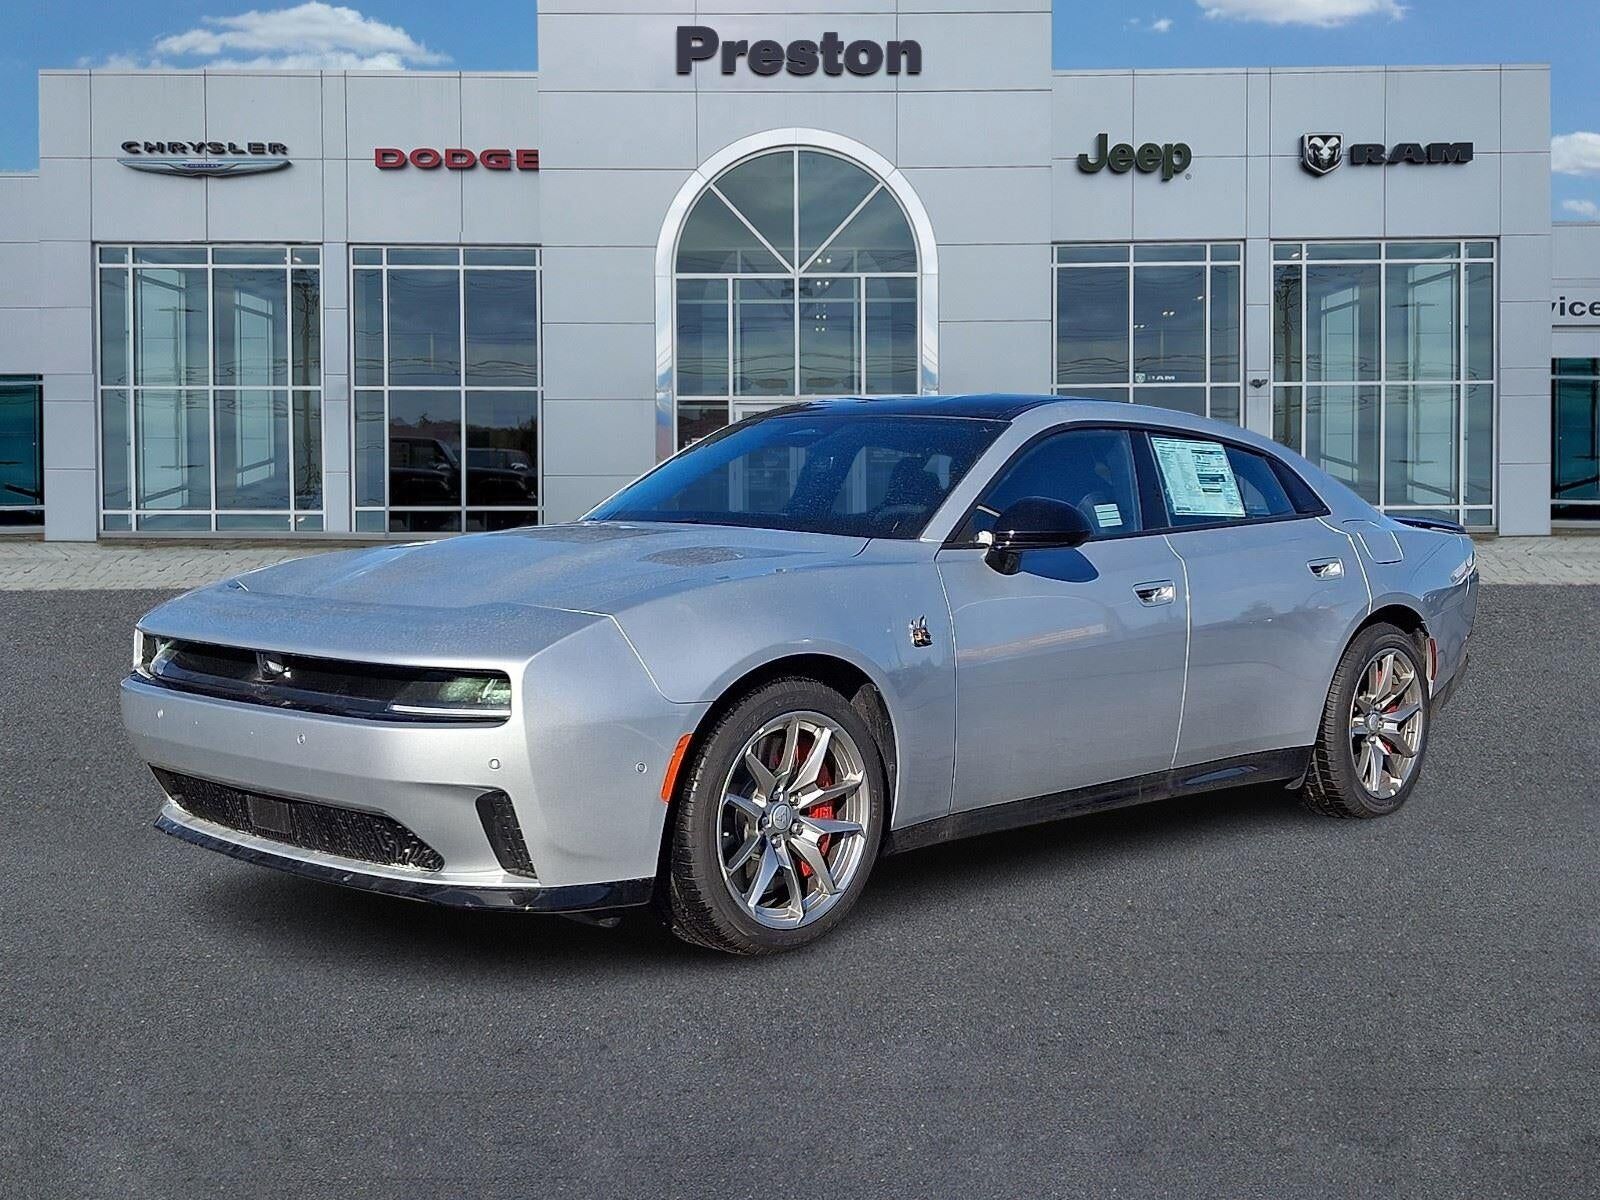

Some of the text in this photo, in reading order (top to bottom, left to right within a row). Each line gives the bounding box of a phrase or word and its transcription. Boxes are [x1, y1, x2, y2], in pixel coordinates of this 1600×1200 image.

[676, 26, 922, 76] Preston
[121, 141, 288, 155] CHRYSLER
[375, 148, 539, 171] DODGE
[1078, 133, 1192, 182] Jeep
[1350, 142, 1474, 165] RAM
